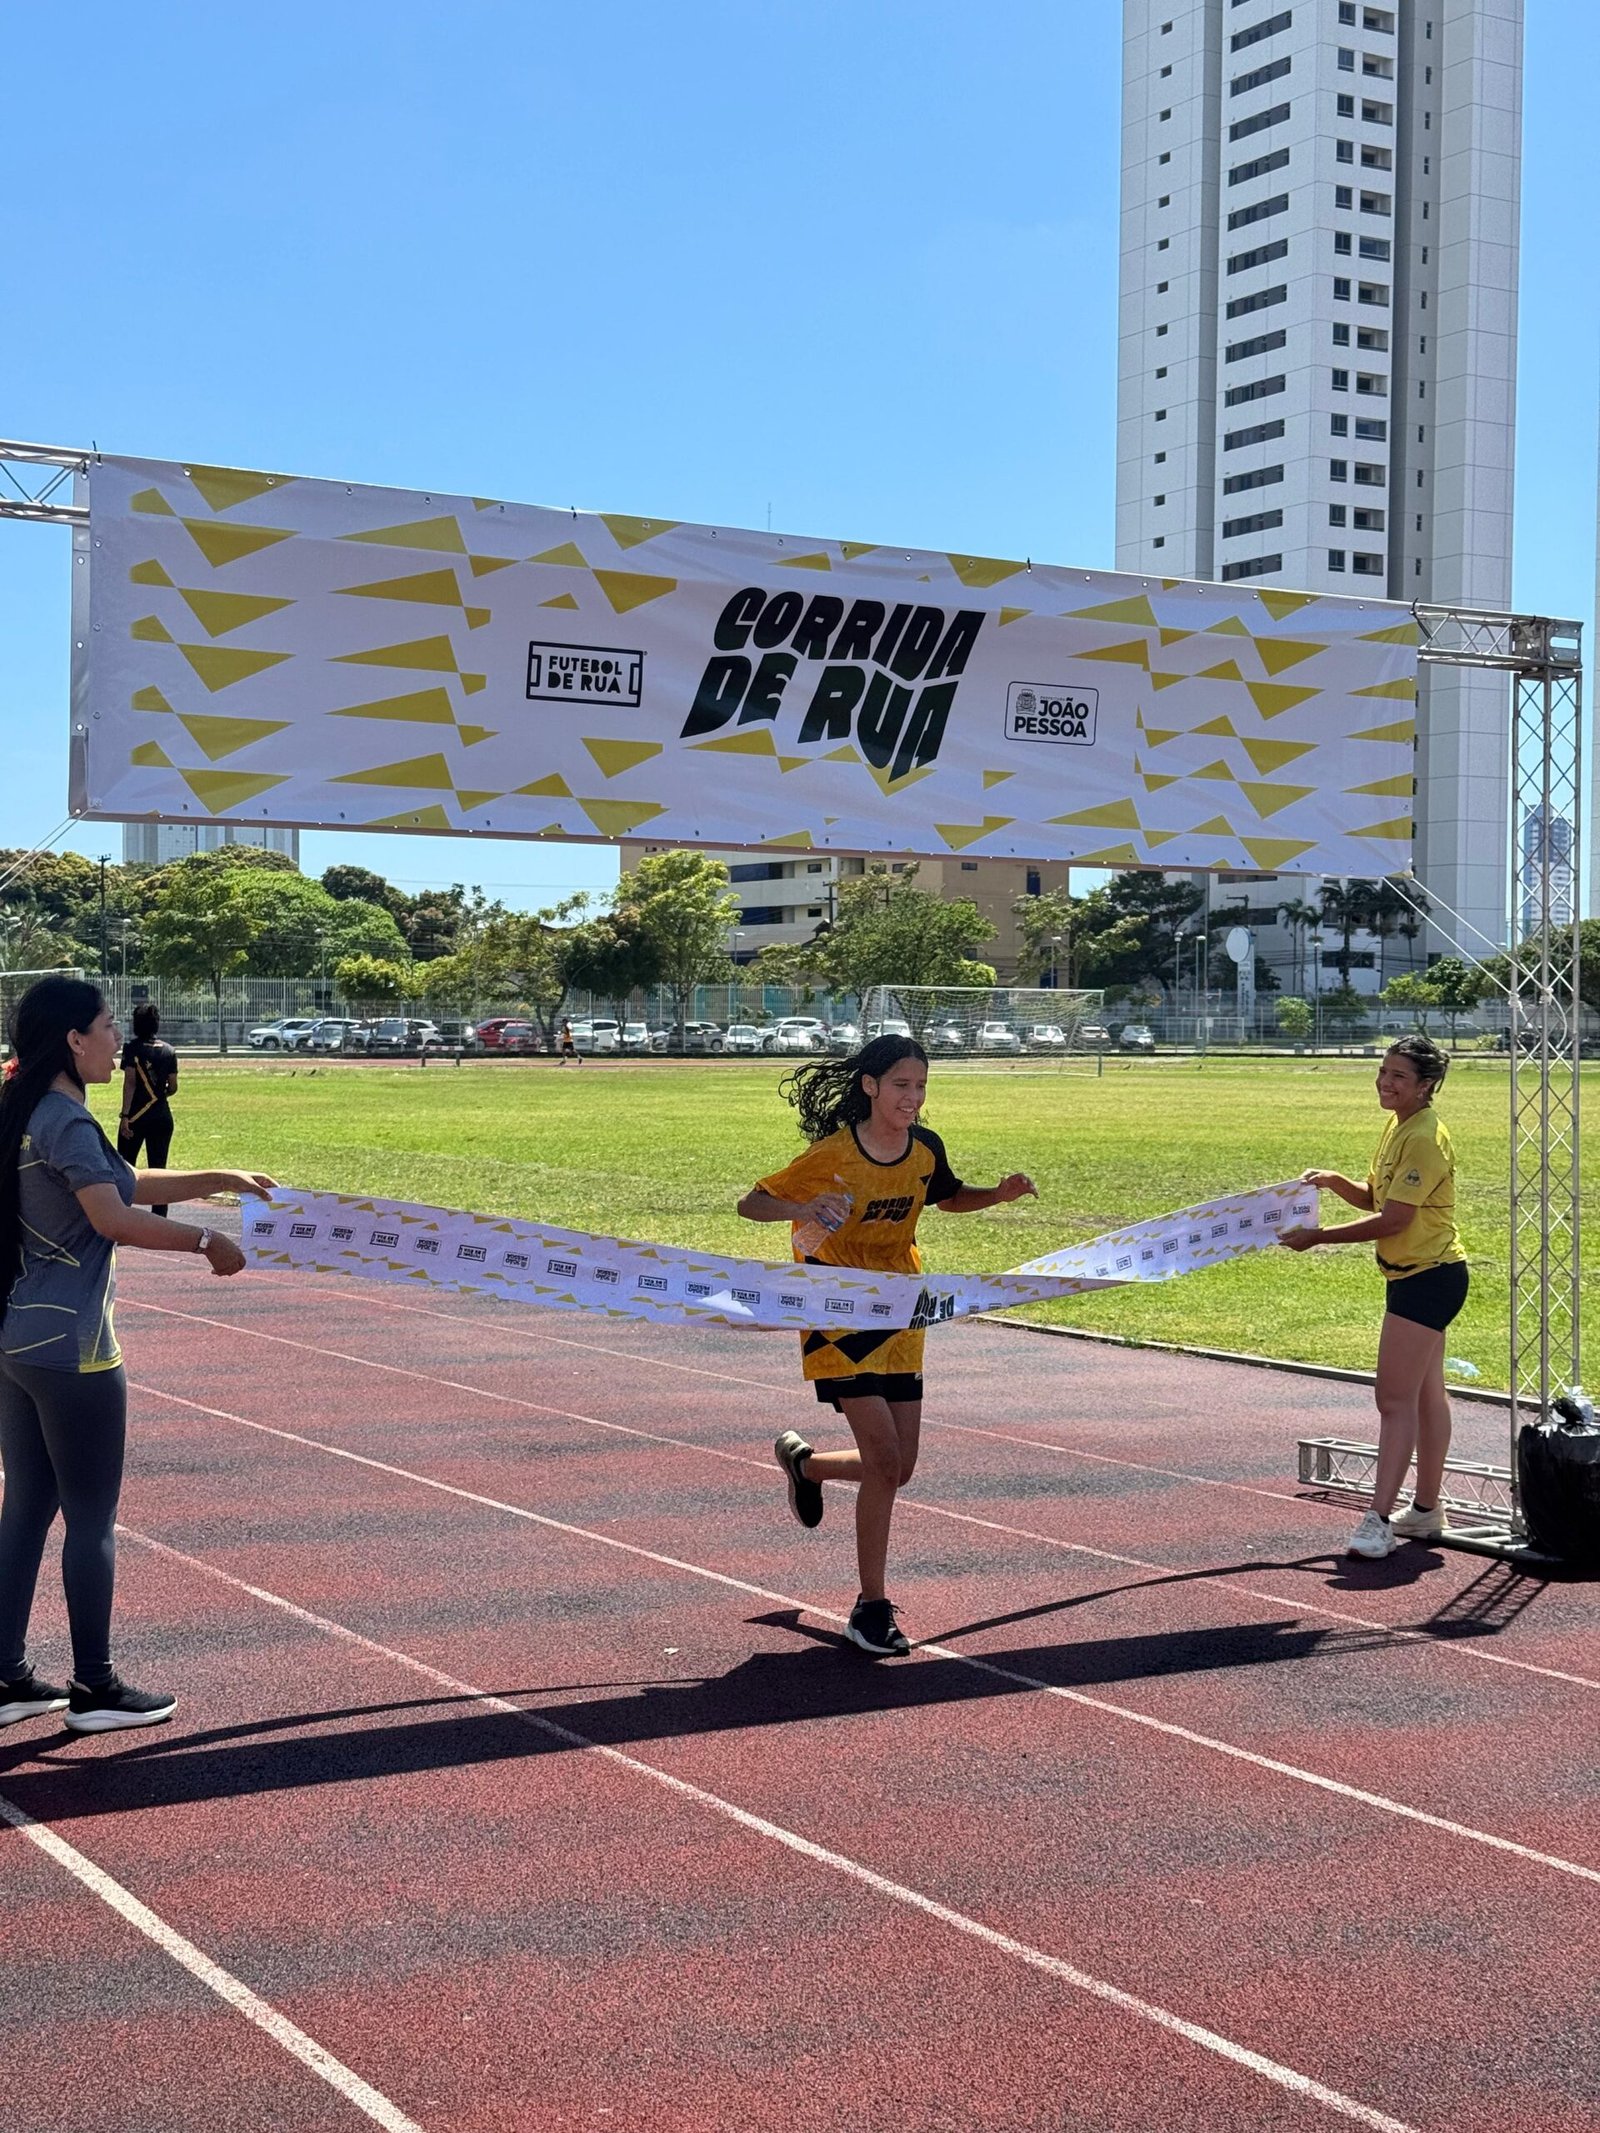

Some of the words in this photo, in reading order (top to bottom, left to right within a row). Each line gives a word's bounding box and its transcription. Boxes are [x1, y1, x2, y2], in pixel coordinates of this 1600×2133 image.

[714, 586, 986, 682] CORRIDA
[549, 655, 622, 675] FUTEBOL
[548, 671, 574, 690] DE
[580, 674, 621, 694] RUA
[680, 652, 798, 738] DE
[797, 665, 958, 783] RUA
[1038, 697, 1089, 720] JOÃO
[1013, 716, 1087, 738] PESSOA
